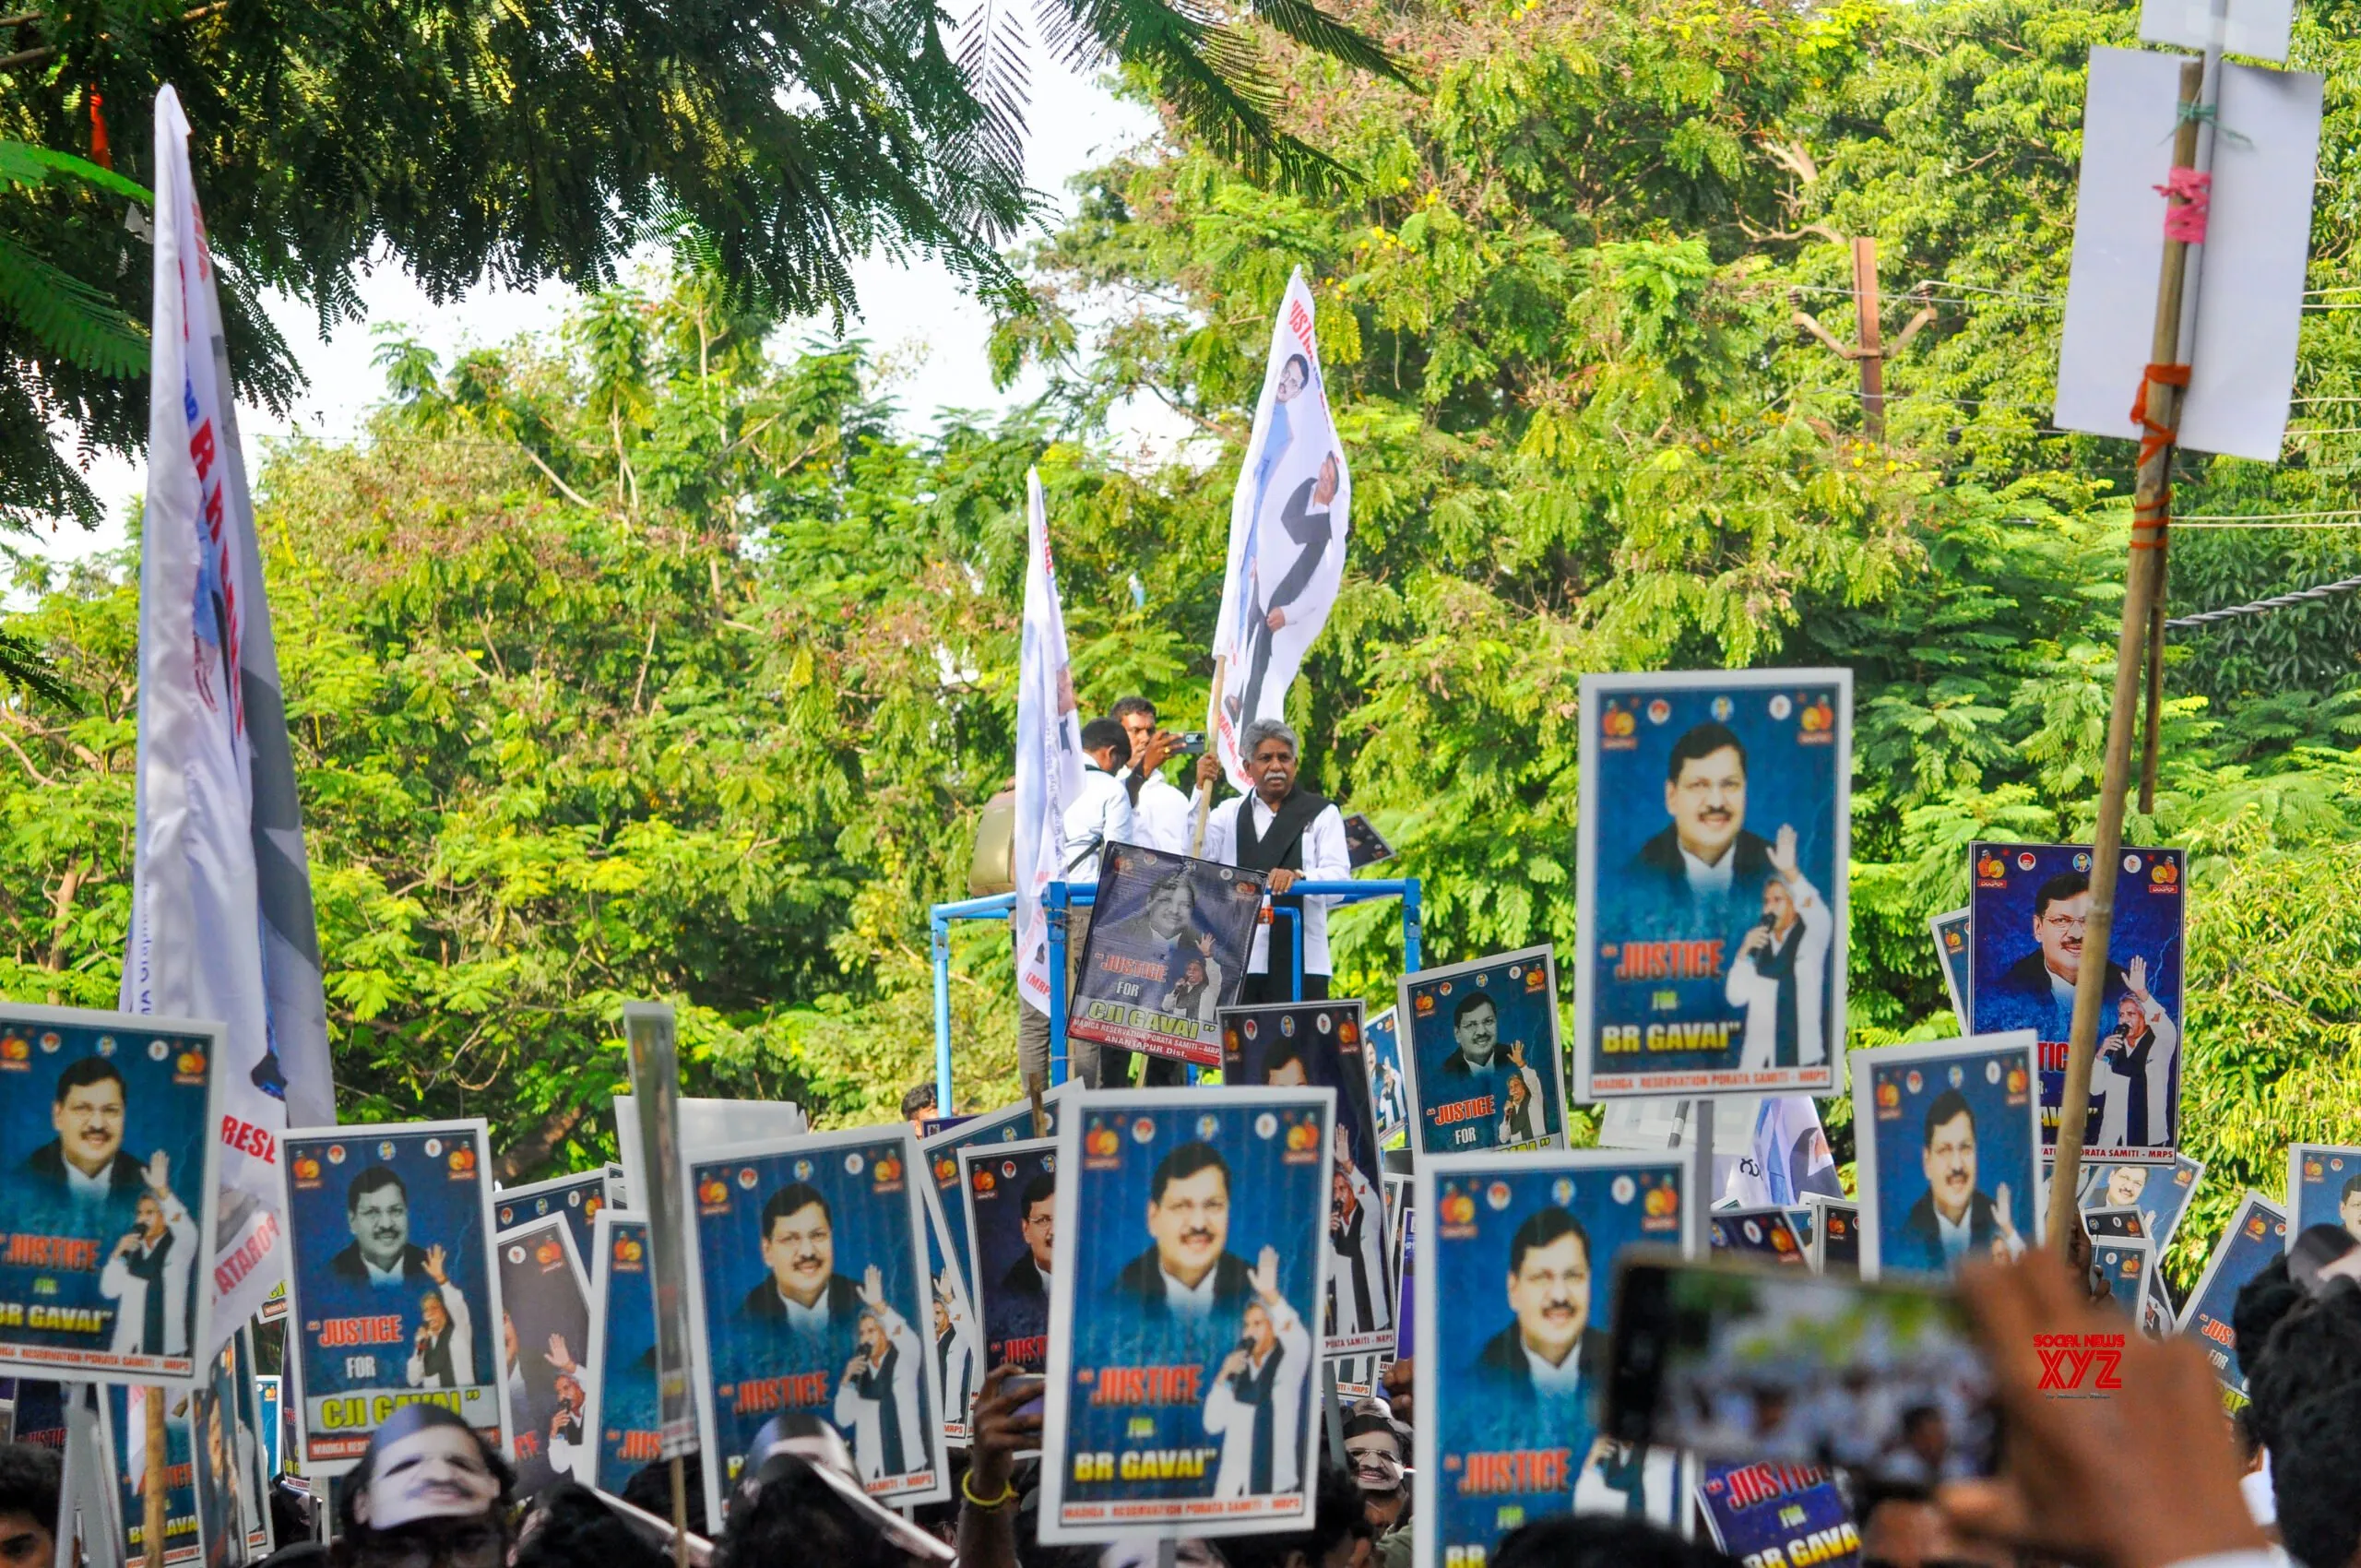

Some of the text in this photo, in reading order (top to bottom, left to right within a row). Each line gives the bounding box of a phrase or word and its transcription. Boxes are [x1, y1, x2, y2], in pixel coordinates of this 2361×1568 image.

[1602, 940, 1725, 980] “JUSTICE
[1116, 980, 1140, 997] FOR
[1088, 1001, 1125, 1025] CJI
[1128, 1008, 1199, 1039] GAVAI
[1073, 1019, 1100, 1031] MADIGA
[1099, 1023, 1146, 1040] RESERVATION
[1146, 1032, 1173, 1046] PORATA
[1173, 1039, 1197, 1051] SAMITI
[1204, 1044, 1220, 1054] MRP
[1104, 1035, 1188, 1058] ANANTAPUR Dist.
[1602, 1024, 1641, 1052] BR
[1426, 1094, 1496, 1126] “JUSTICE
[1454, 1126, 1477, 1145] FOR
[2081, 1147, 2106, 1158] ORATA
[2108, 1147, 2140, 1158] SAMITI
[2148, 1148, 2174, 1158] MRPS
[306, 1314, 404, 1348] “JUSTICE
[1376, 1334, 1394, 1344] MRPS
[346, 1355, 376, 1378] FOR
[719, 1372, 829, 1416] “JUSTICE
[1077, 1364, 1204, 1407] “JUSTICE
[323, 1397, 367, 1429] CJI
[1073, 1451, 1114, 1482] BR
[1444, 1446, 1572, 1498] “JUSTICE
